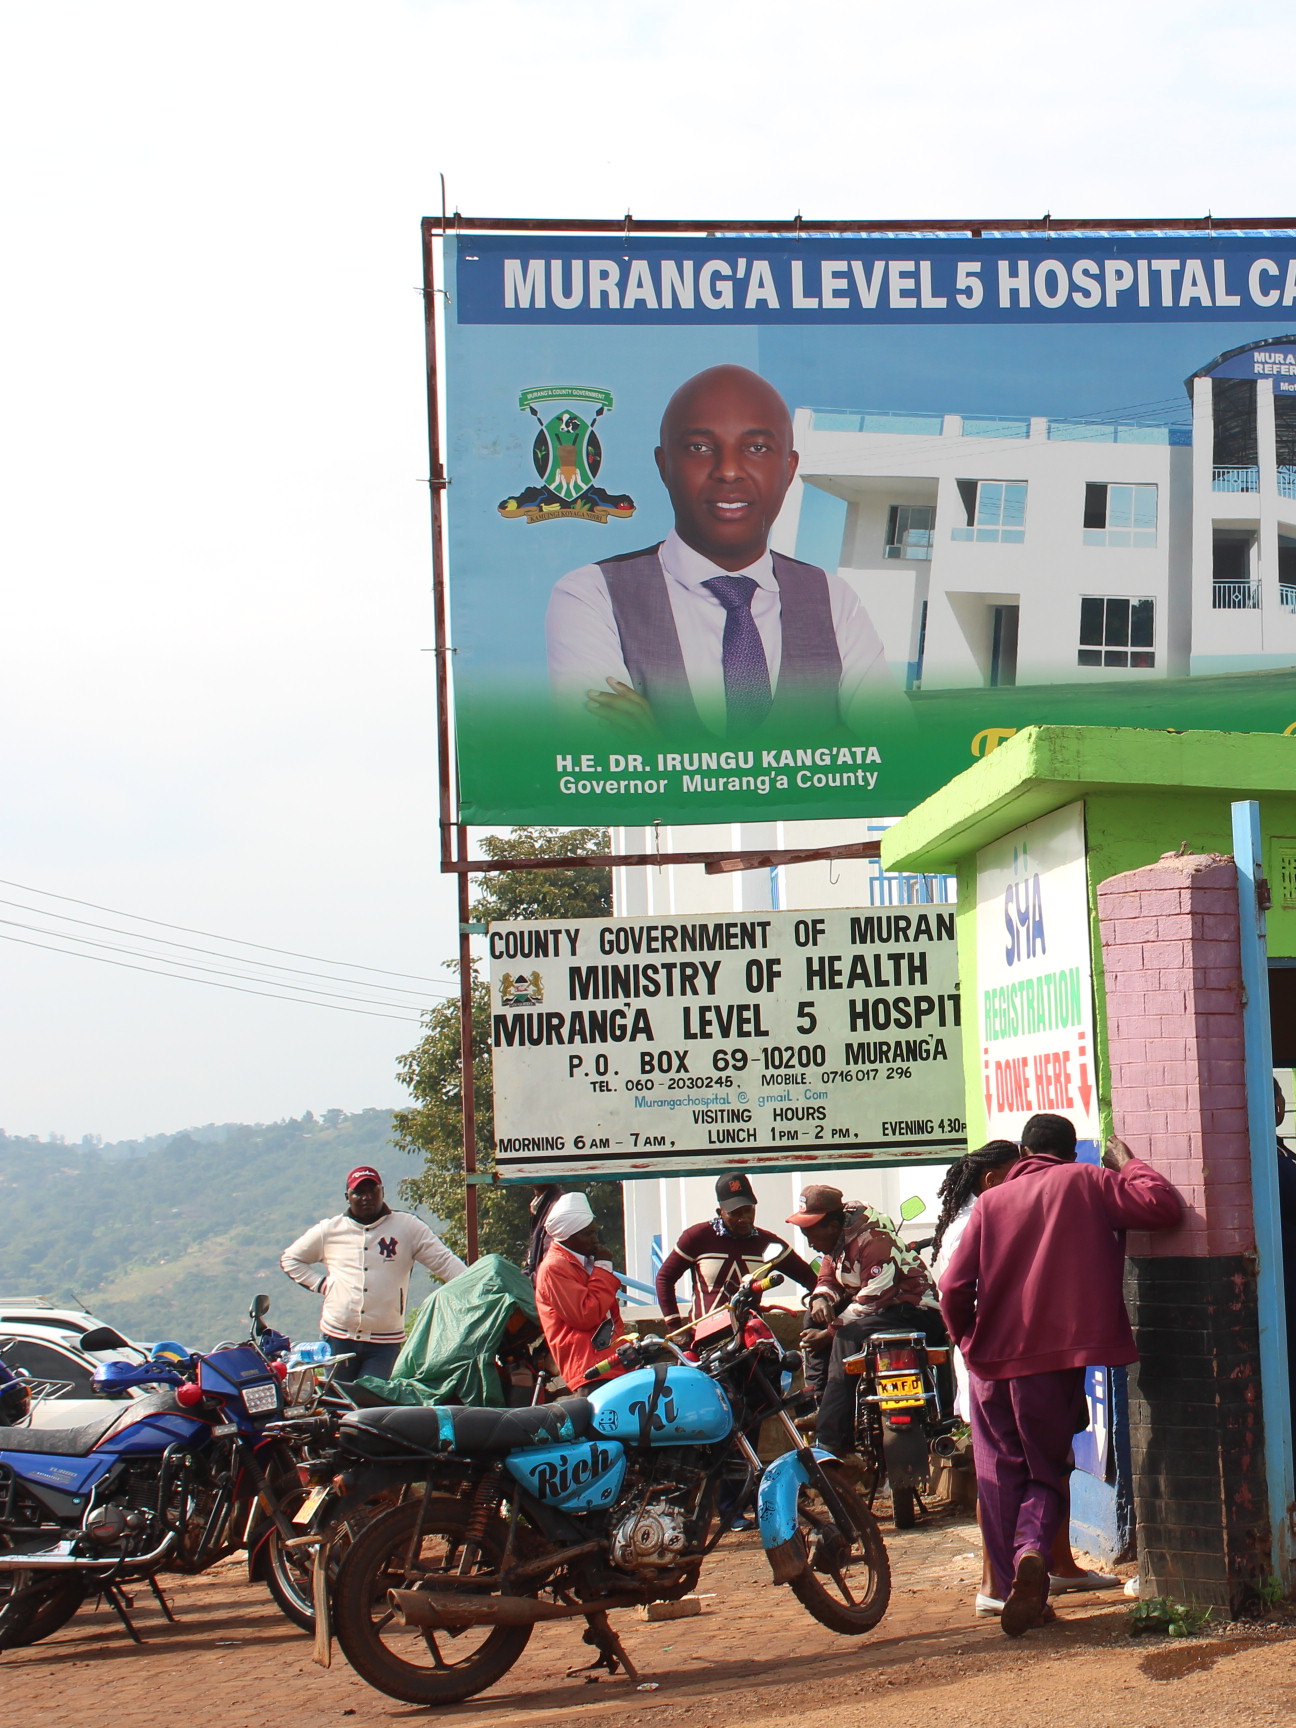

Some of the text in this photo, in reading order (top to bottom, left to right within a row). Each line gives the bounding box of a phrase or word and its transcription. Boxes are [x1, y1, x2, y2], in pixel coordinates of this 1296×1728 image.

[504, 258, 780, 309] MURANG'A
[791, 260, 947, 309] LEVEL
[955, 261, 984, 309] 5
[997, 258, 1241, 309] HOSPITAL
[572, 390, 605, 399] GOVERNMENT
[556, 746, 882, 772] H.E. DR. IRUNGU KANG'ATA
[559, 768, 878, 794] Governor Murang'a County
[489, 913, 955, 960] COUNTY GOVERNMENT OF MURAN
[1004, 870, 1046, 967] SHA
[569, 952, 928, 1000] MINISTRY OF HEALTH
[493, 1002, 655, 1047] MURANG'A
[683, 1003, 769, 1040] LEVEL
[796, 1001, 817, 1035] 5
[984, 966, 1081, 1042] REGISTRATION
[640, 1050, 689, 1075] BOX
[845, 1034, 948, 1066] MURANG'A
[590, 1080, 618, 1092] TEL.
[761, 1072, 812, 1086] MOBILE.
[995, 1051, 1074, 1113] DONE HERE
[499, 1135, 565, 1153] MORNING
[708, 1127, 757, 1144] LUNCH
[882, 1119, 934, 1136] EVENING
[692, 1106, 827, 1125] VISITING HOURS
[528, 1441, 614, 1499] Rich
